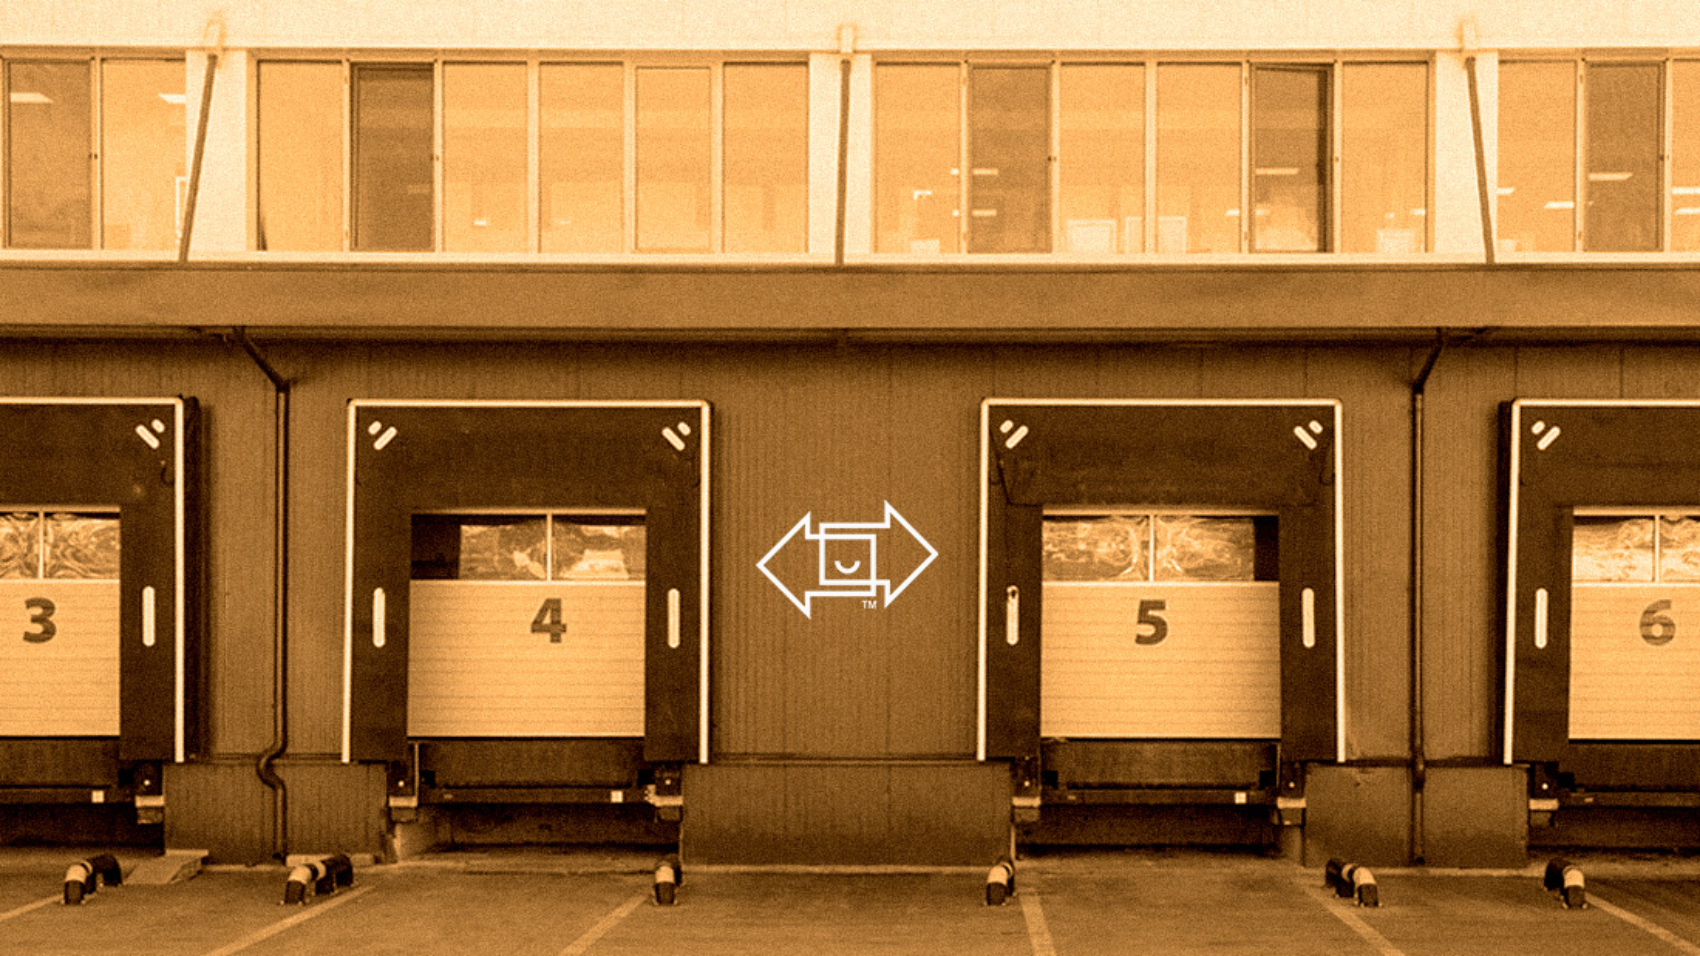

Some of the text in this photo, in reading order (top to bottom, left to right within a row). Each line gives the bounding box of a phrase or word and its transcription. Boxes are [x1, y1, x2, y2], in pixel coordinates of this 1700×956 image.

[23, 598, 57, 644] 3
[530, 598, 567, 643] 4
[1134, 600, 1169, 646] 5
[1638, 600, 1676, 646] 6
